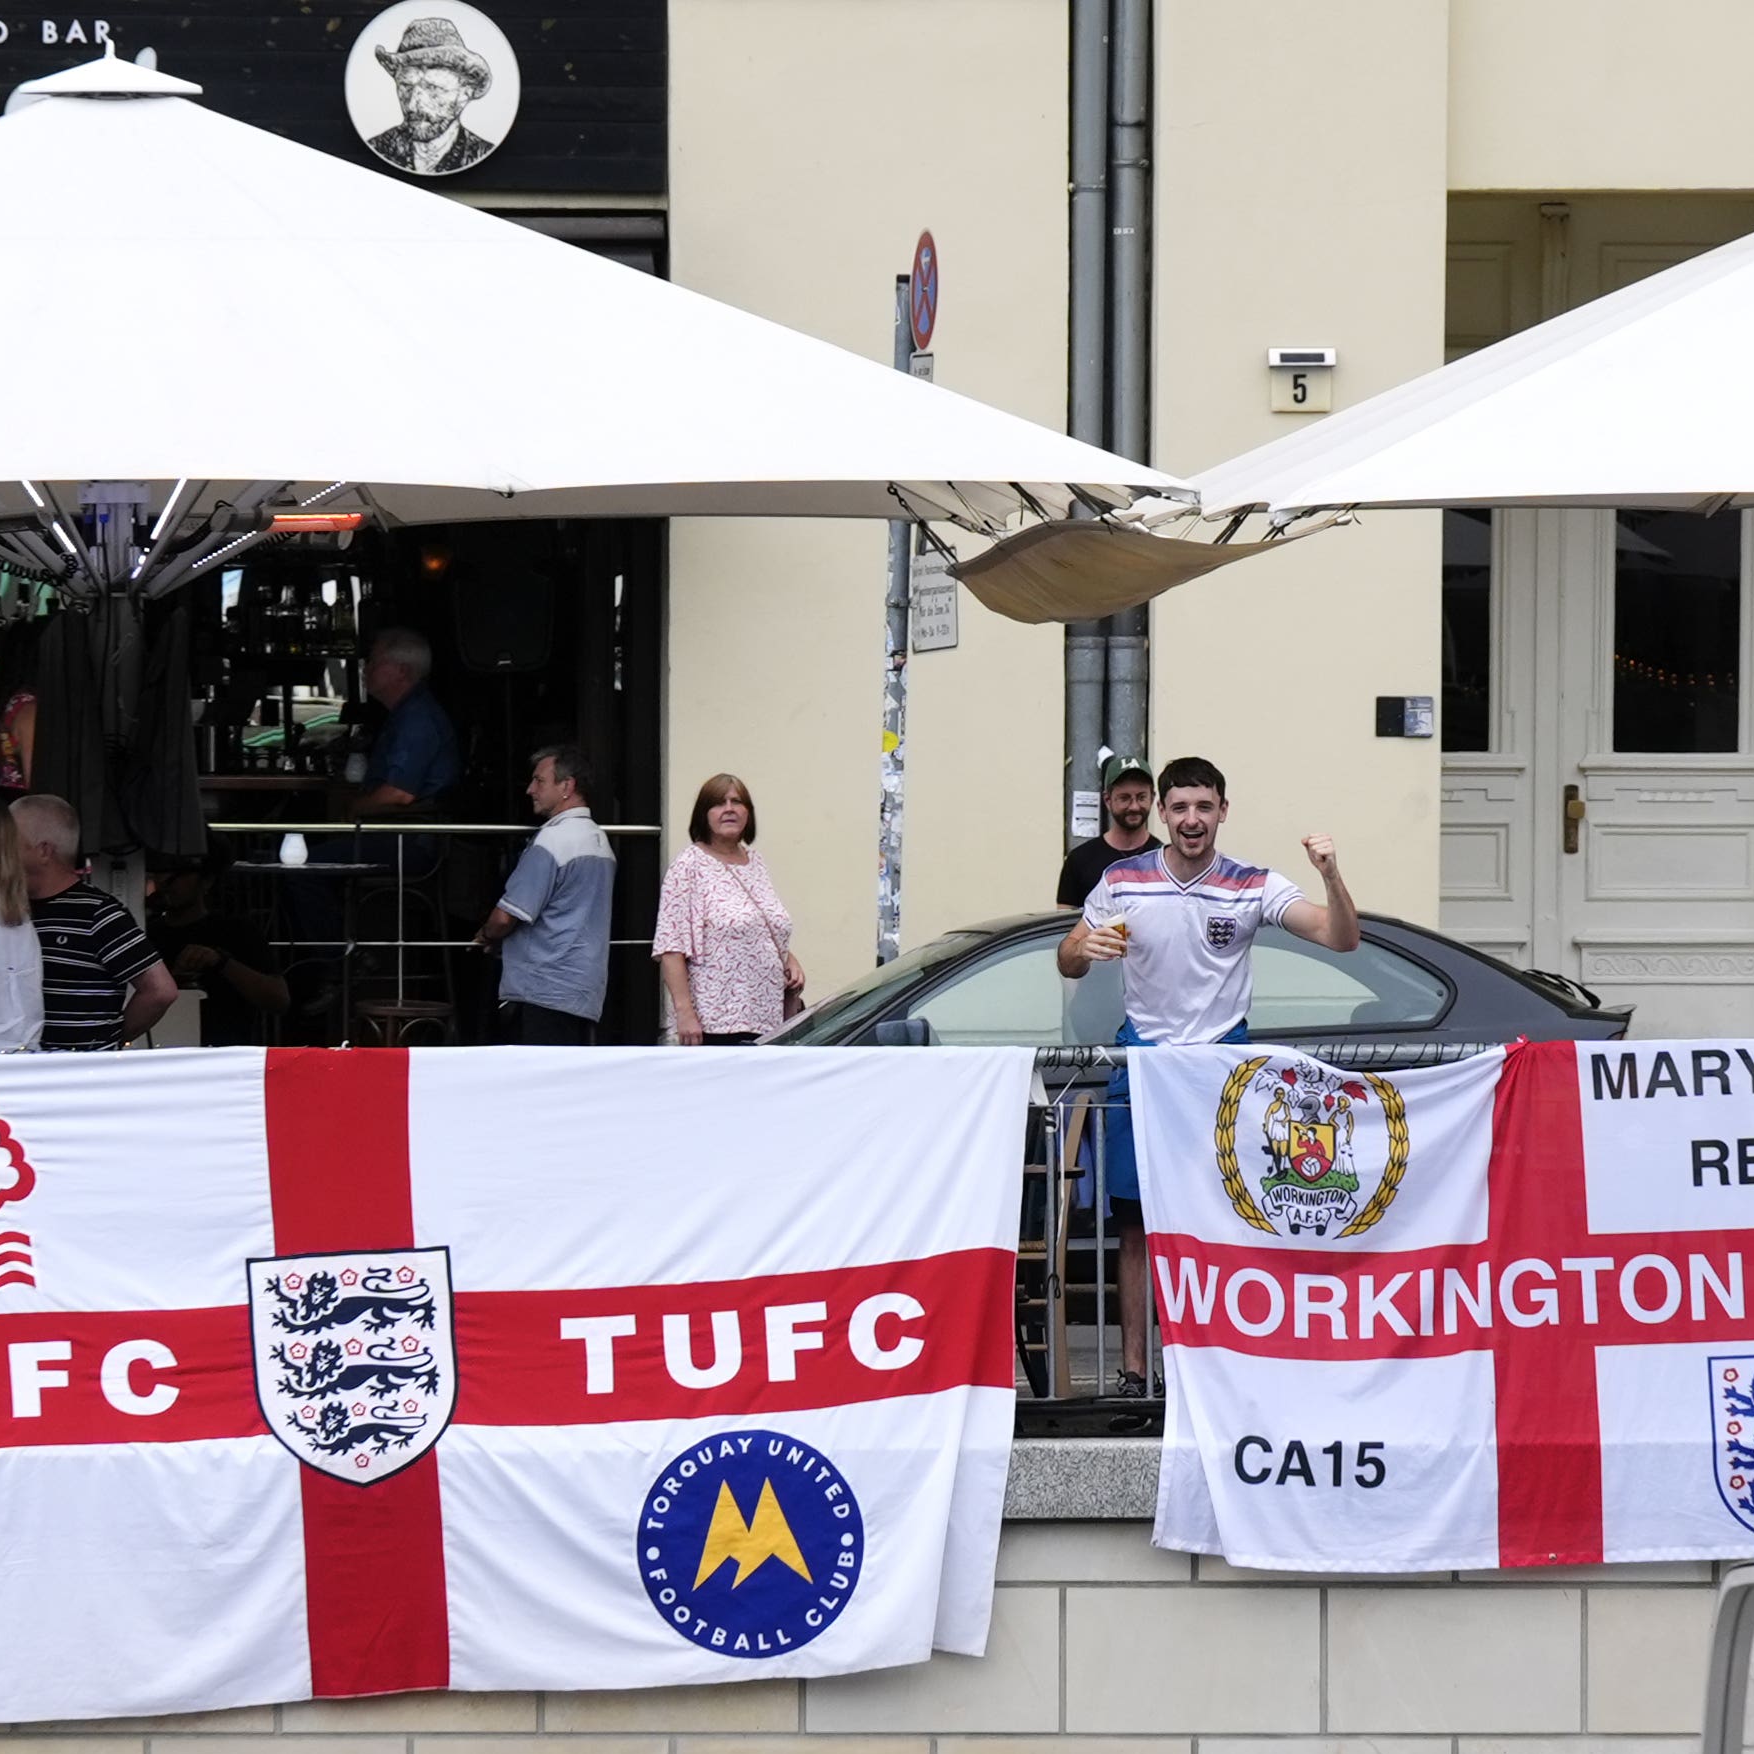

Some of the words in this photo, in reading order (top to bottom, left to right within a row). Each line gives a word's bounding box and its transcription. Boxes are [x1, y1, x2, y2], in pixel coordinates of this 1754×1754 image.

[42, 19, 113, 44] BAR
[1292, 374, 1308, 404] 5
[1272, 1186, 1347, 1207] WORKINGTON
[1294, 1209, 1325, 1224] A.F.C.
[1154, 1252, 1746, 1341] WORKINGTON
[560, 1292, 926, 1395] TUFC
[646, 1437, 753, 1530] TORQUAY
[767, 1439, 850, 1519] UNITED
[1234, 1435, 1386, 1489] CA15
[649, 1567, 792, 1651] FOOTBALL
[805, 1551, 854, 1627] CLUB
